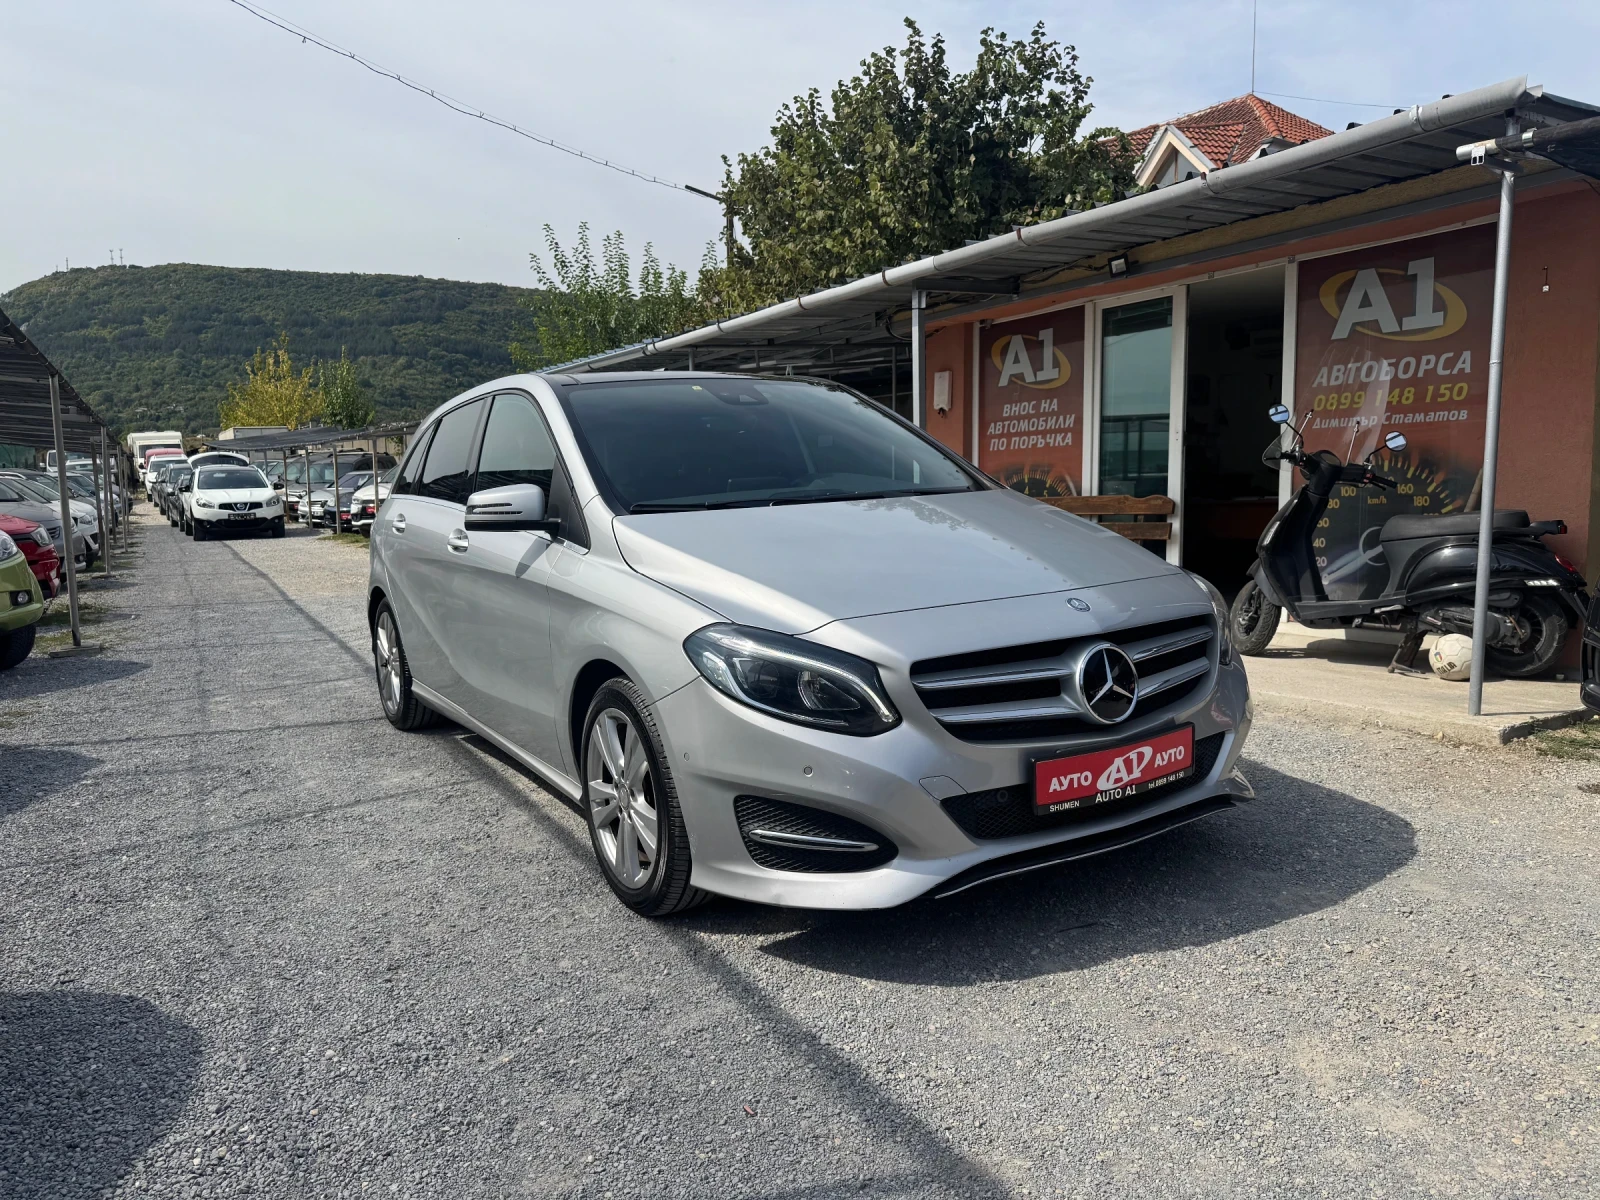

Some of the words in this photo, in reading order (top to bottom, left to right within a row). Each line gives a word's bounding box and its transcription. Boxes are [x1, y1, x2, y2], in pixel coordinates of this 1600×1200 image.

[1331, 257, 1444, 340] A1
[998, 328, 1060, 387] A1
[1312, 350, 1471, 387] АВТОБОРСА
[1313, 391, 1366, 411] 0899
[1375, 387, 1415, 406] 148
[1425, 382, 1469, 403] 150
[1003, 401, 1036, 417] ВНОС
[1040, 398, 1058, 413] НА
[987, 414, 1075, 435] АВТОМОБИЛИ
[1382, 410, 1468, 425] Стаматов
[989, 438, 1007, 451] ПО
[1010, 432, 1072, 450] ПОРЪЧКА
[1340, 486, 1356, 497] 100
[1397, 484, 1414, 494] 160
[1367, 496, 1387, 505] km/h
[1413, 496, 1430, 506] 180
[1049, 771, 1092, 793] АУТО
[1154, 746, 1185, 768] АУТО
[1095, 789, 1122, 803] AUTO
[1125, 785, 1137, 797] A1
[1050, 800, 1080, 812] SHUMEN
